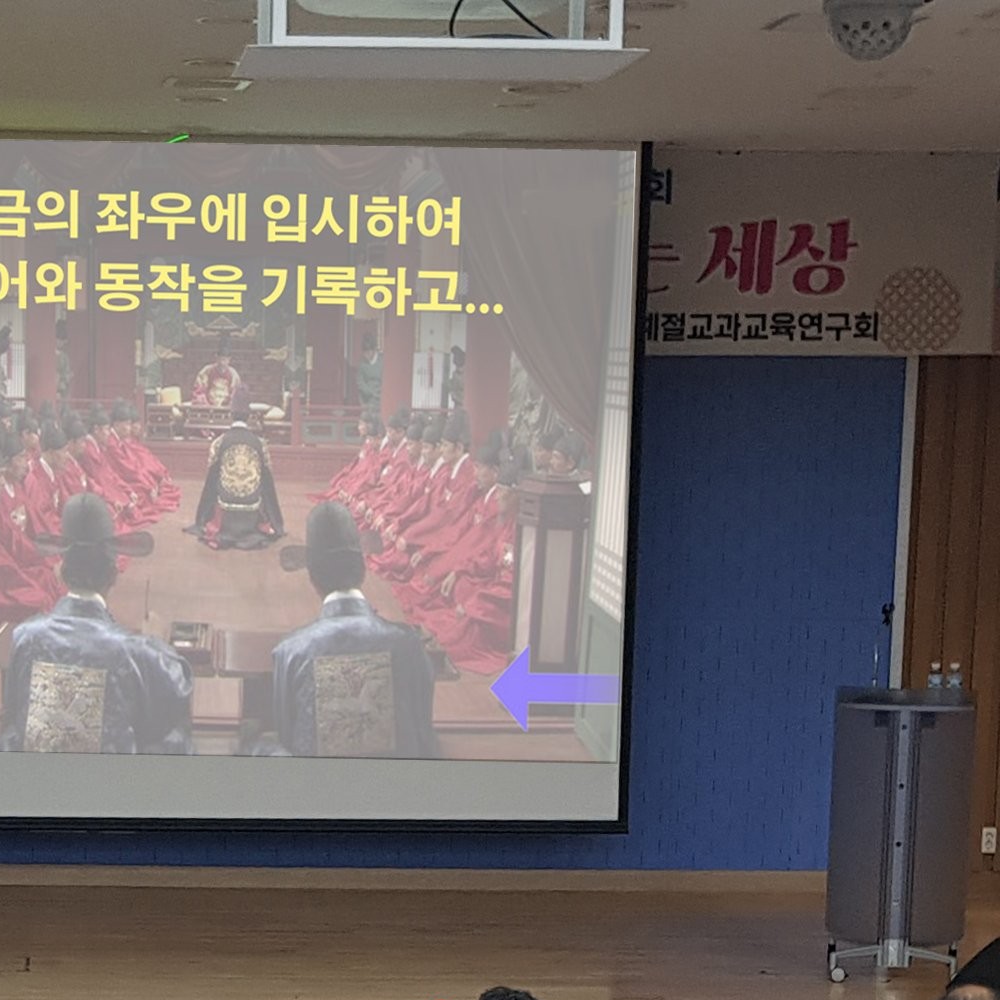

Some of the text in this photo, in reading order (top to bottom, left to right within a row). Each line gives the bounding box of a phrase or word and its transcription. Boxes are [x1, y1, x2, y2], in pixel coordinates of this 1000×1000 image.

[96, 191, 246, 242] 좌우에
[263, 194, 462, 246] 입시하여
[696, 218, 858, 296] 세상
[95, 263, 247, 313] 동작을
[263, 265, 504, 317] 기록하고...
